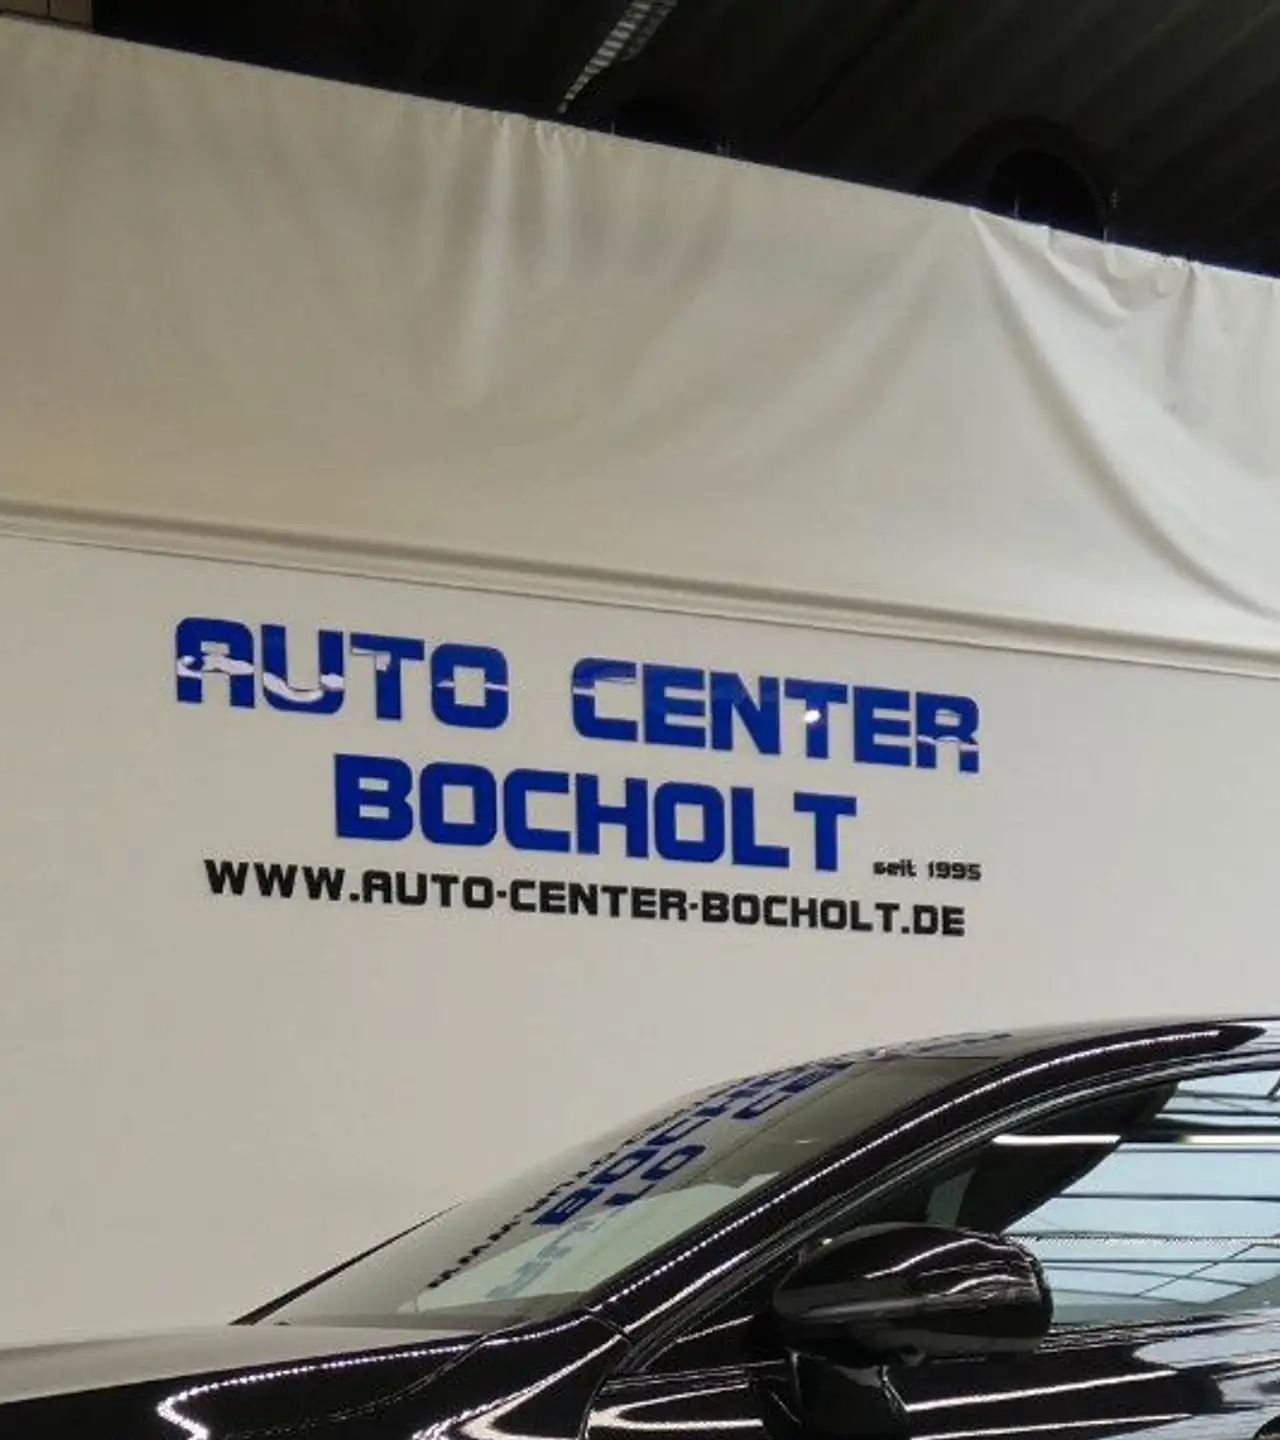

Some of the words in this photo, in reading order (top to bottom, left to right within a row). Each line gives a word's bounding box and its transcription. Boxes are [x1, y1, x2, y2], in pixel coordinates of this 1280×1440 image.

[176, 617, 509, 729] AUTO
[571, 657, 980, 774] CENTER
[334, 753, 858, 872] BOCHOLT
[204, 859, 965, 937] WWW.AUTO-CENTER-BOCHOLT.DE
[872, 859, 917, 877] seit
[927, 861, 982, 881] 1995
